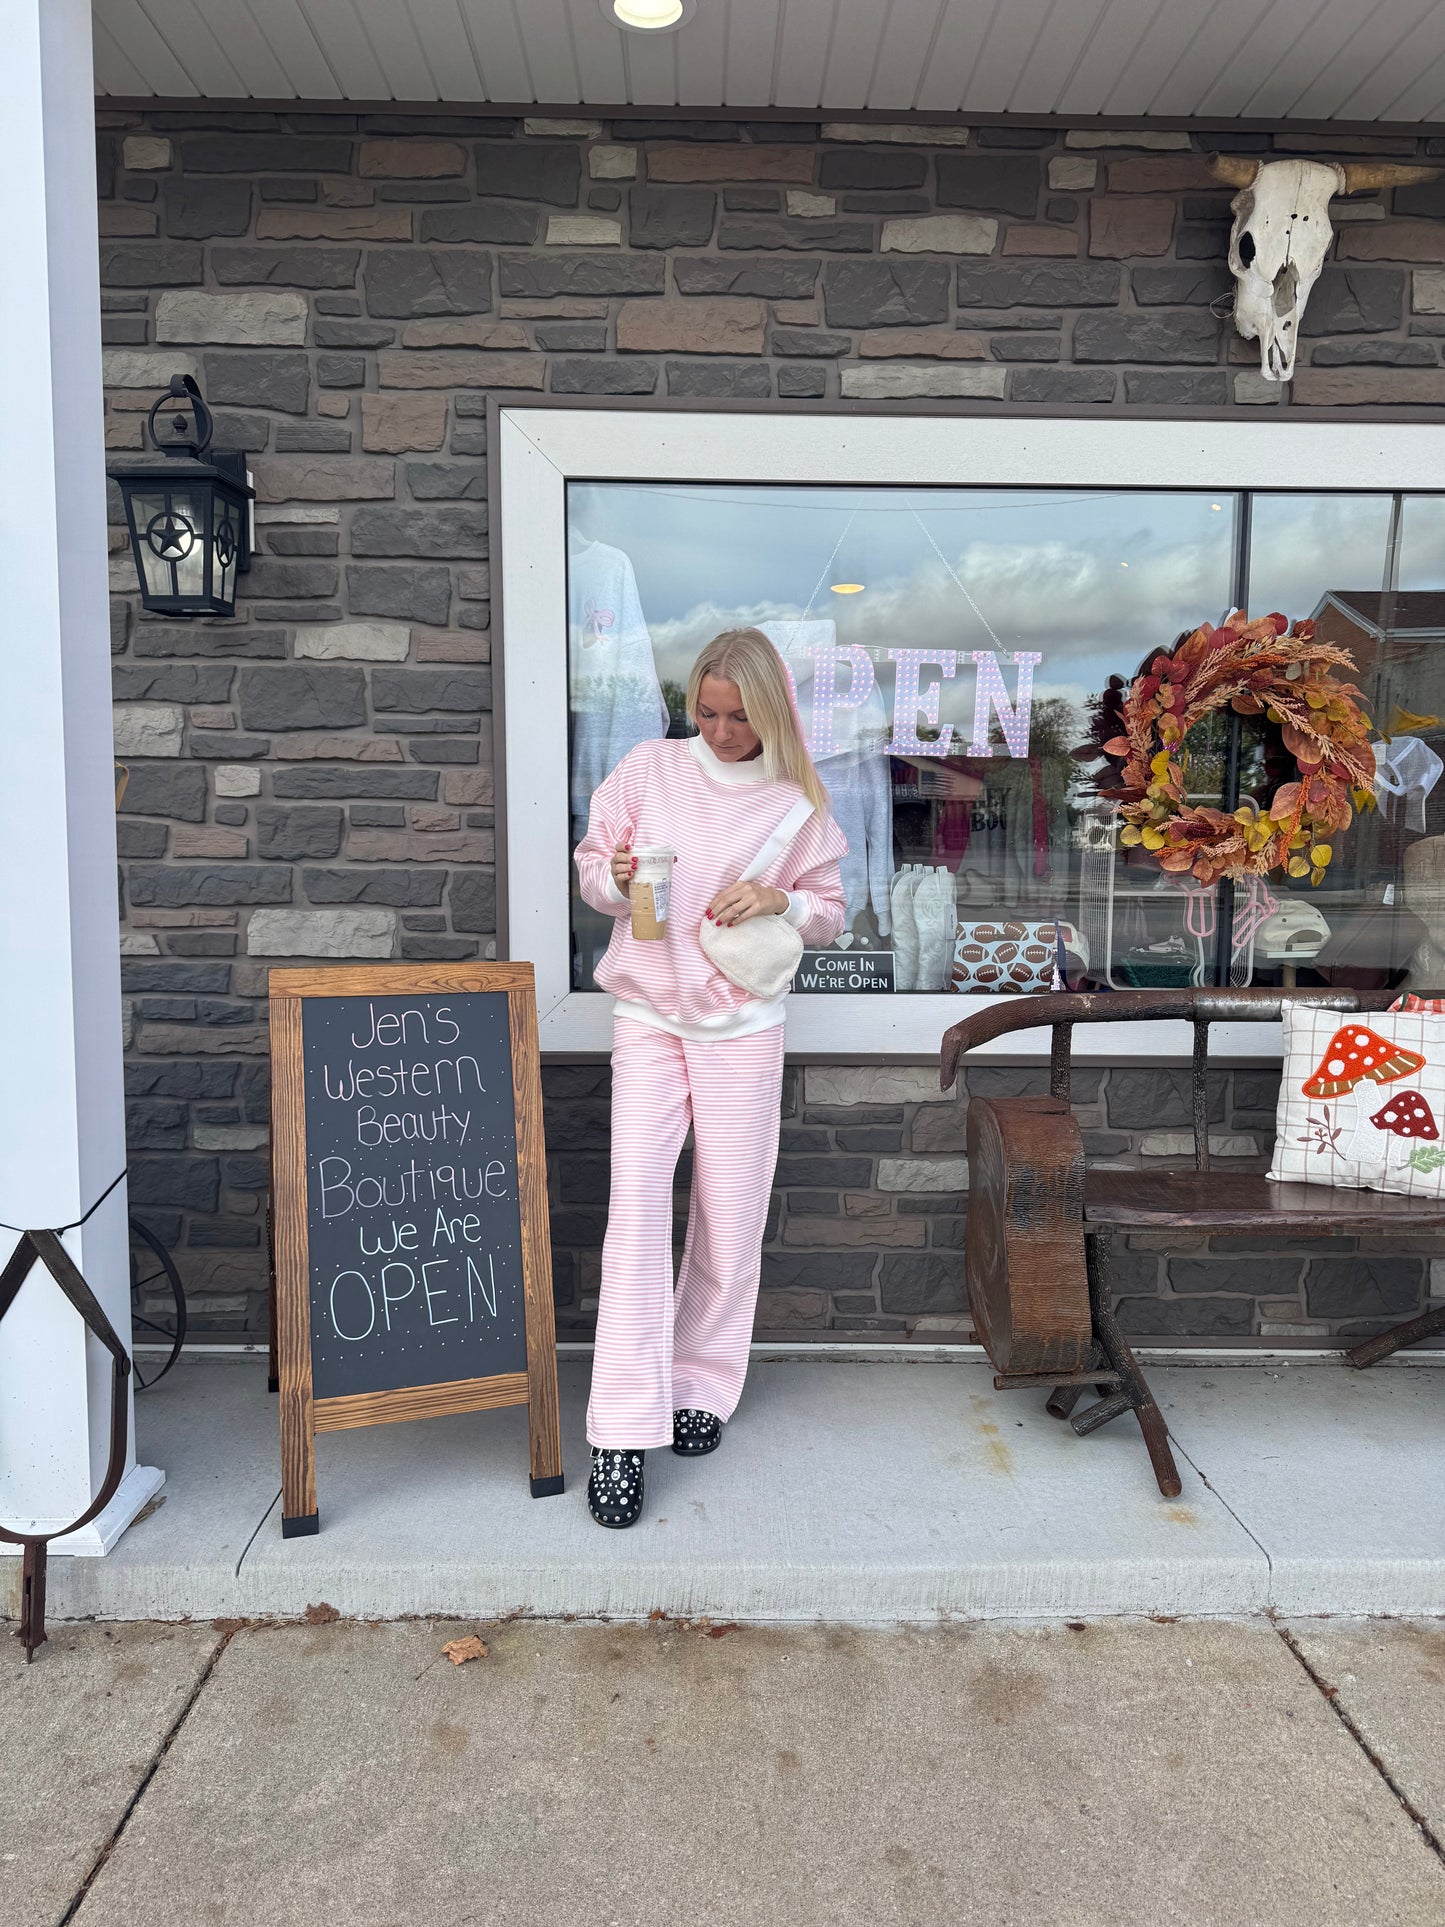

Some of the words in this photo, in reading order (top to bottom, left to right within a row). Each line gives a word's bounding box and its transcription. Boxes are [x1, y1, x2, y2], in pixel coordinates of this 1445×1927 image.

[780, 646, 1042, 758] PEN
[351, 1002, 460, 1049] Jen's
[324, 1055, 486, 1101] Western
[357, 1104, 470, 1146] Beauty
[319, 1156, 507, 1218] Boutique
[360, 1220, 419, 1255] We
[432, 1207, 482, 1247] Are
[329, 1254, 498, 1341] OPEN
